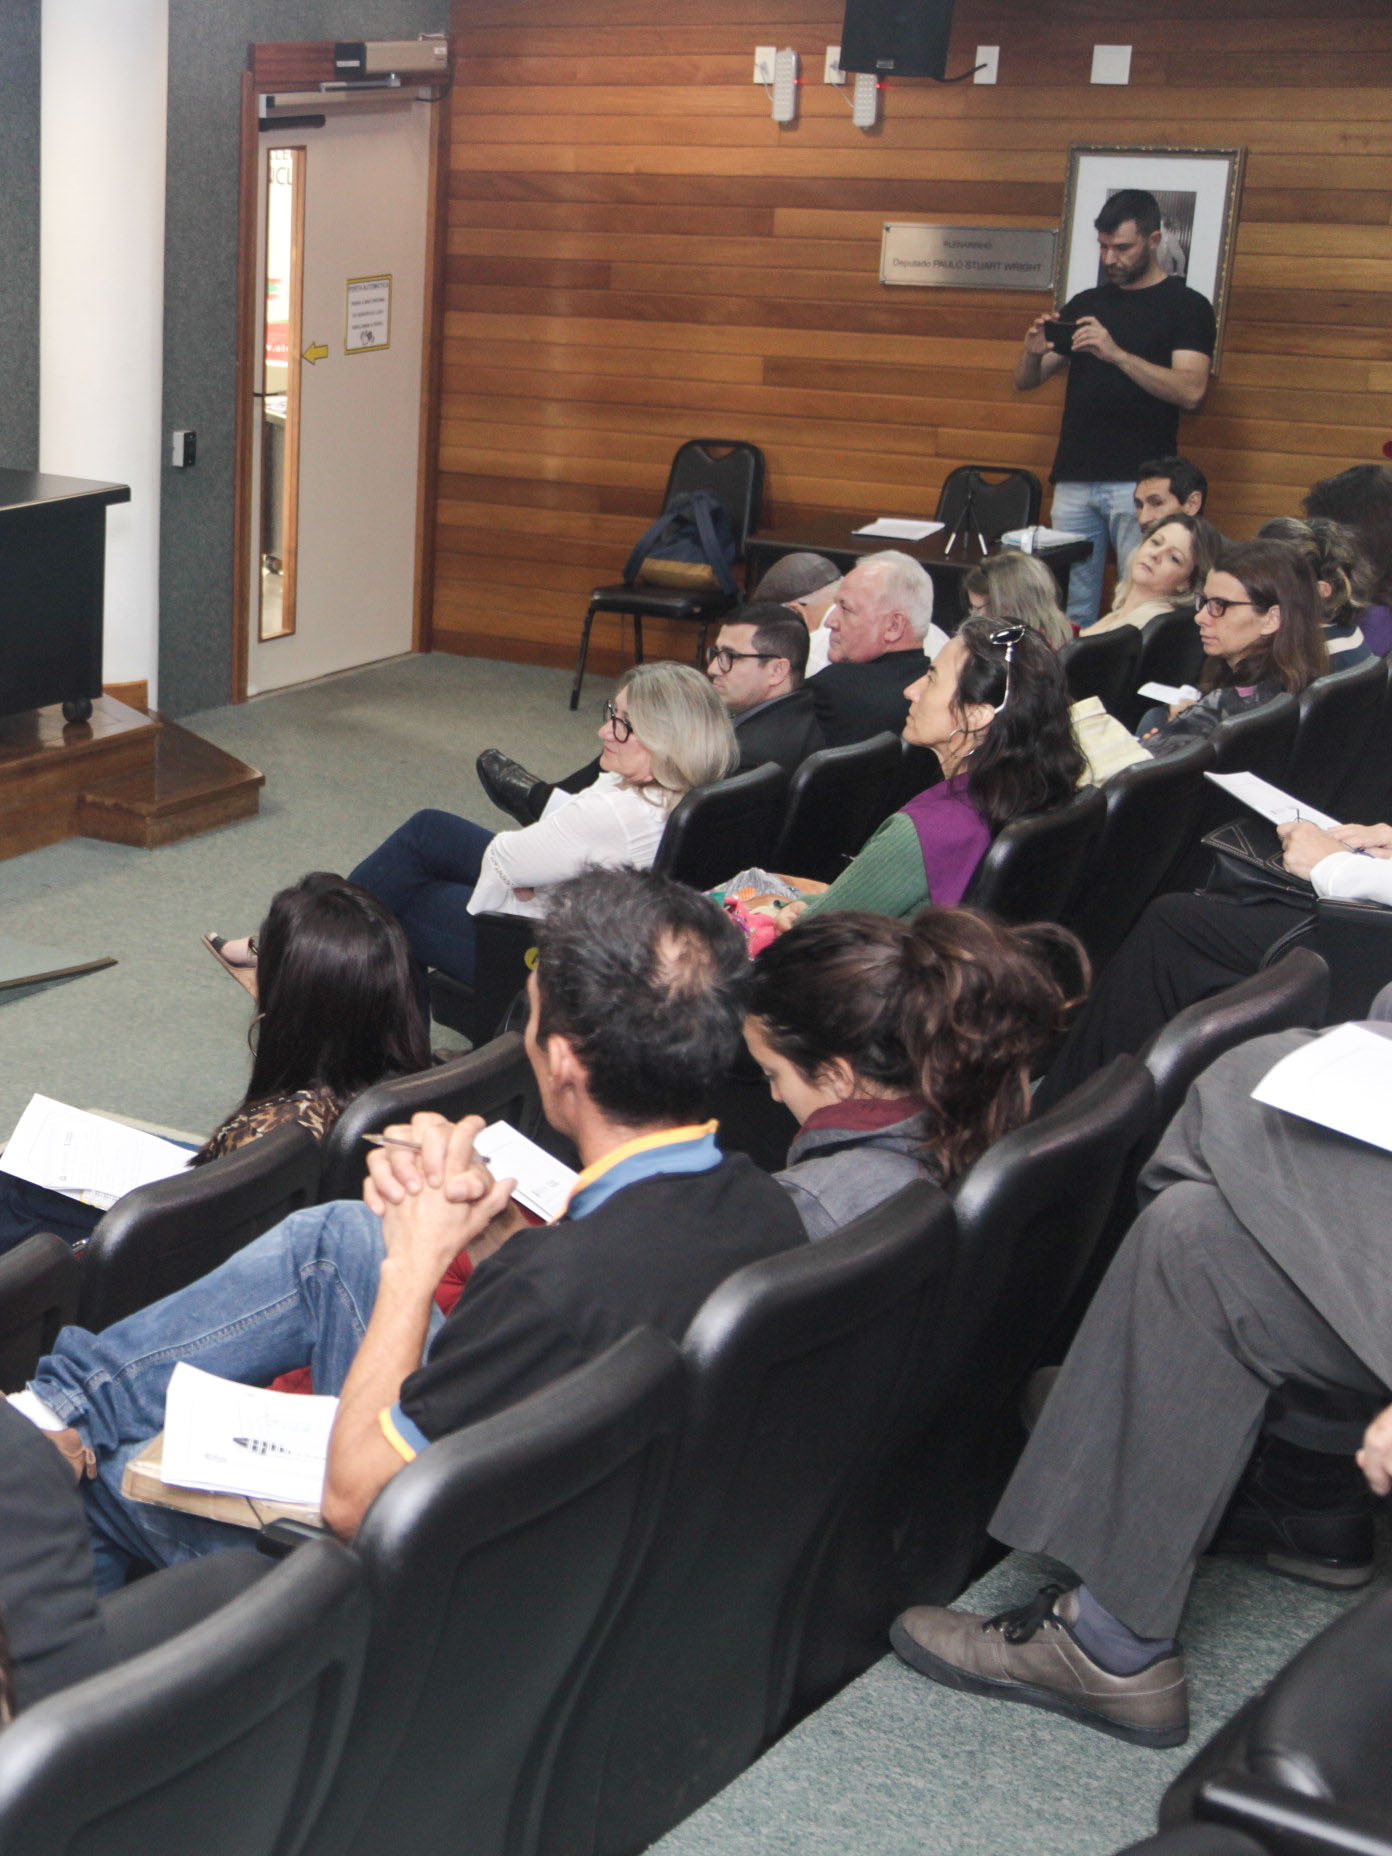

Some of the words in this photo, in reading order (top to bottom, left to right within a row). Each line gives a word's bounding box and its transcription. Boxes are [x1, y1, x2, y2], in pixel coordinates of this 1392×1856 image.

[893, 258, 931, 269] Deputado
[933, 260, 963, 270] PAULO
[965, 261, 1000, 271] STUART
[1004, 262, 1042, 273] WRIGHT
